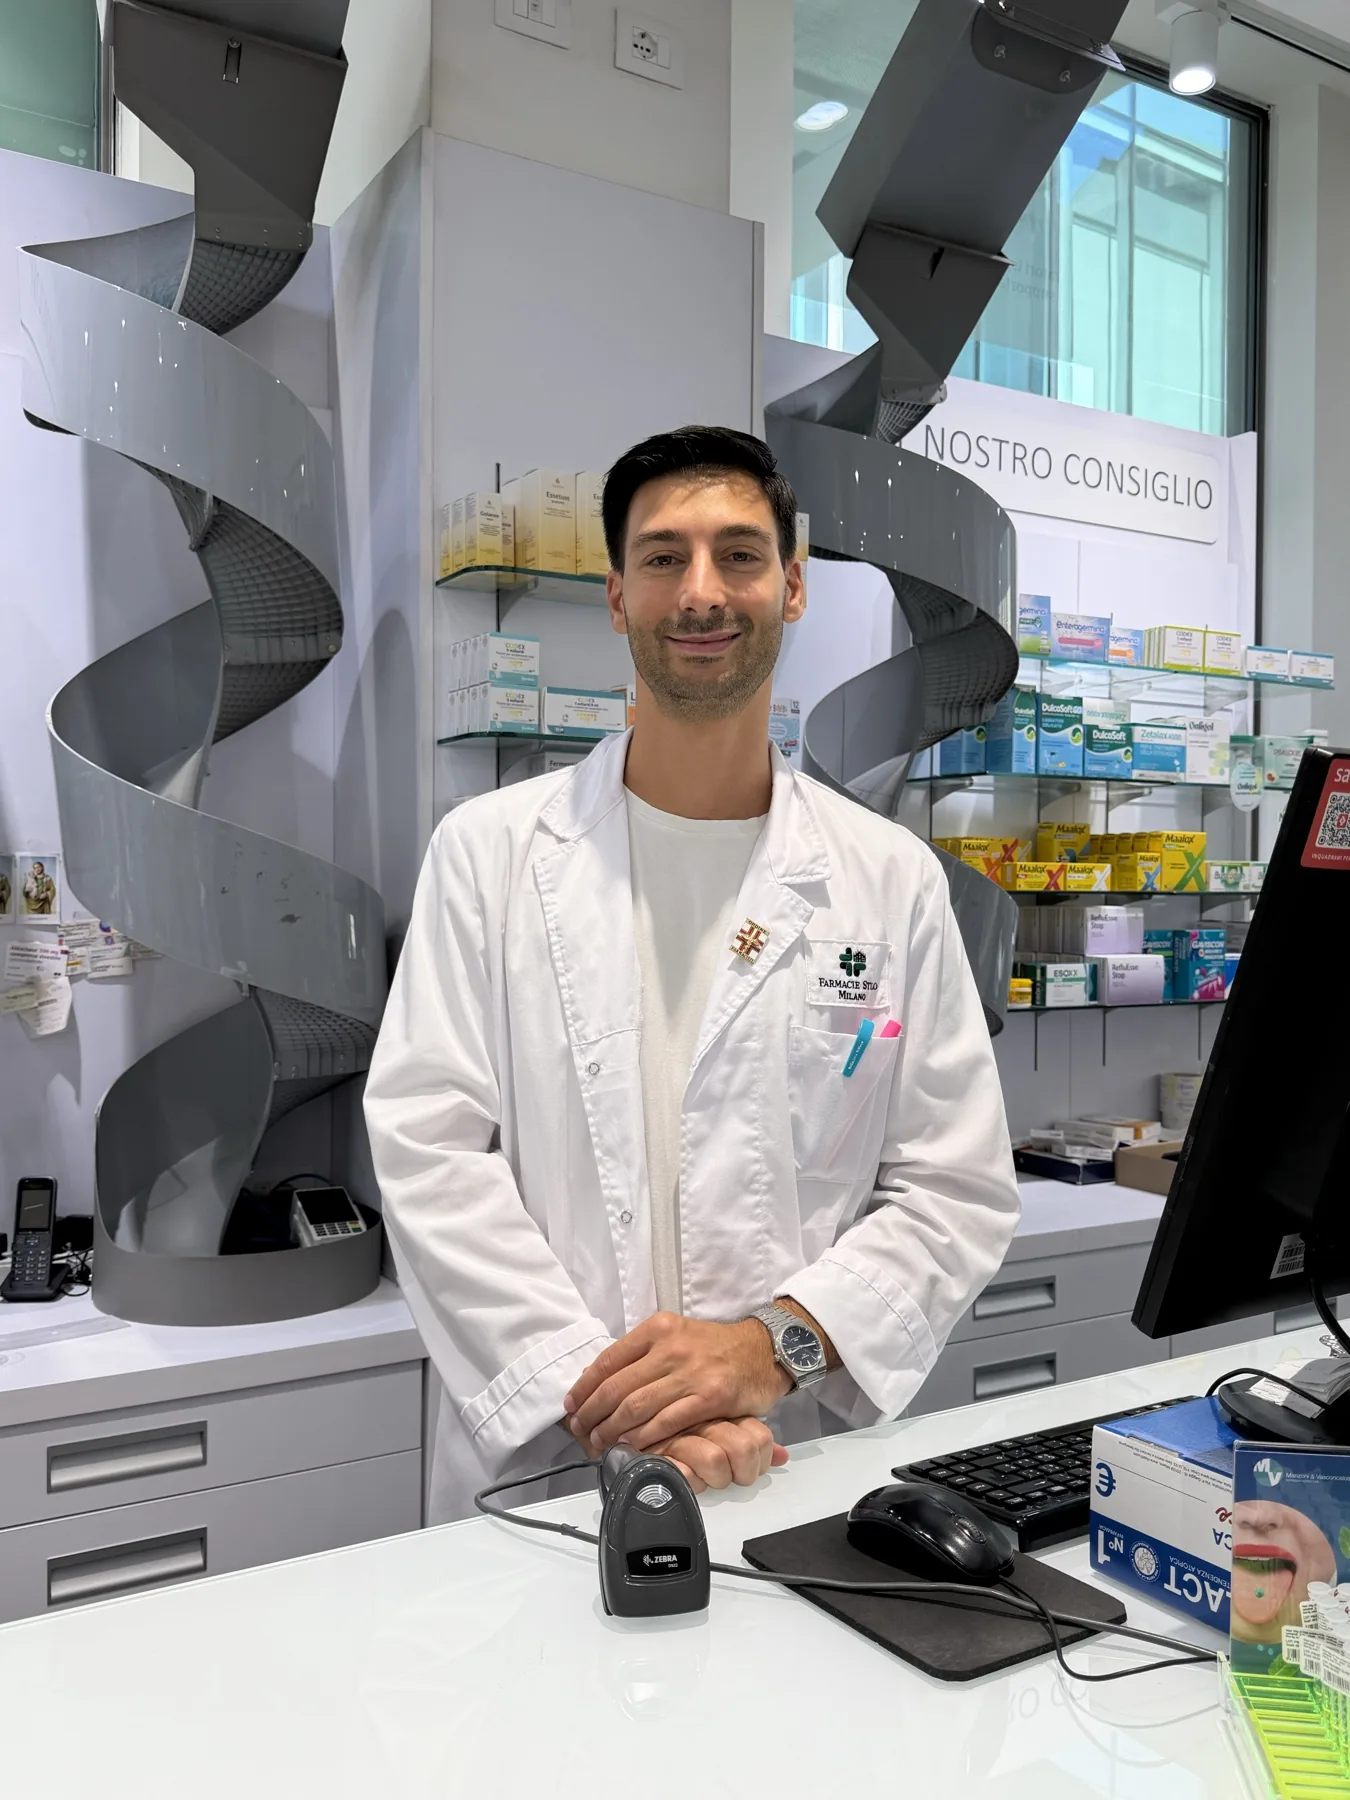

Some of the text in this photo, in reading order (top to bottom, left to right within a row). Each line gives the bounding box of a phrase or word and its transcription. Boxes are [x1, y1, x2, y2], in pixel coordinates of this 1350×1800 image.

[924, 424, 1213, 511] NOSTRO CONSIGLIO
[1041, 702, 1073, 714] DulcoSoft
[1092, 729, 1126, 741] DulcoSoft
[1056, 824, 1087, 835] Maalox
[1165, 834, 1196, 844] Maalox
[963, 842, 990, 852] Maalox
[1018, 864, 1048, 874] Maalox
[1068, 865, 1096, 874] Maalox
[1090, 921, 1105, 930] Stop
[1111, 971, 1126, 980] Stop
[818, 977, 861, 990] FARMACIE
[838, 990, 866, 1001] MILANO
[1285, 1472, 1310, 1480] Manzoni
[654, 1554, 678, 1564] ZEBRA
[1168, 1555, 1196, 1574] ATOPICA
